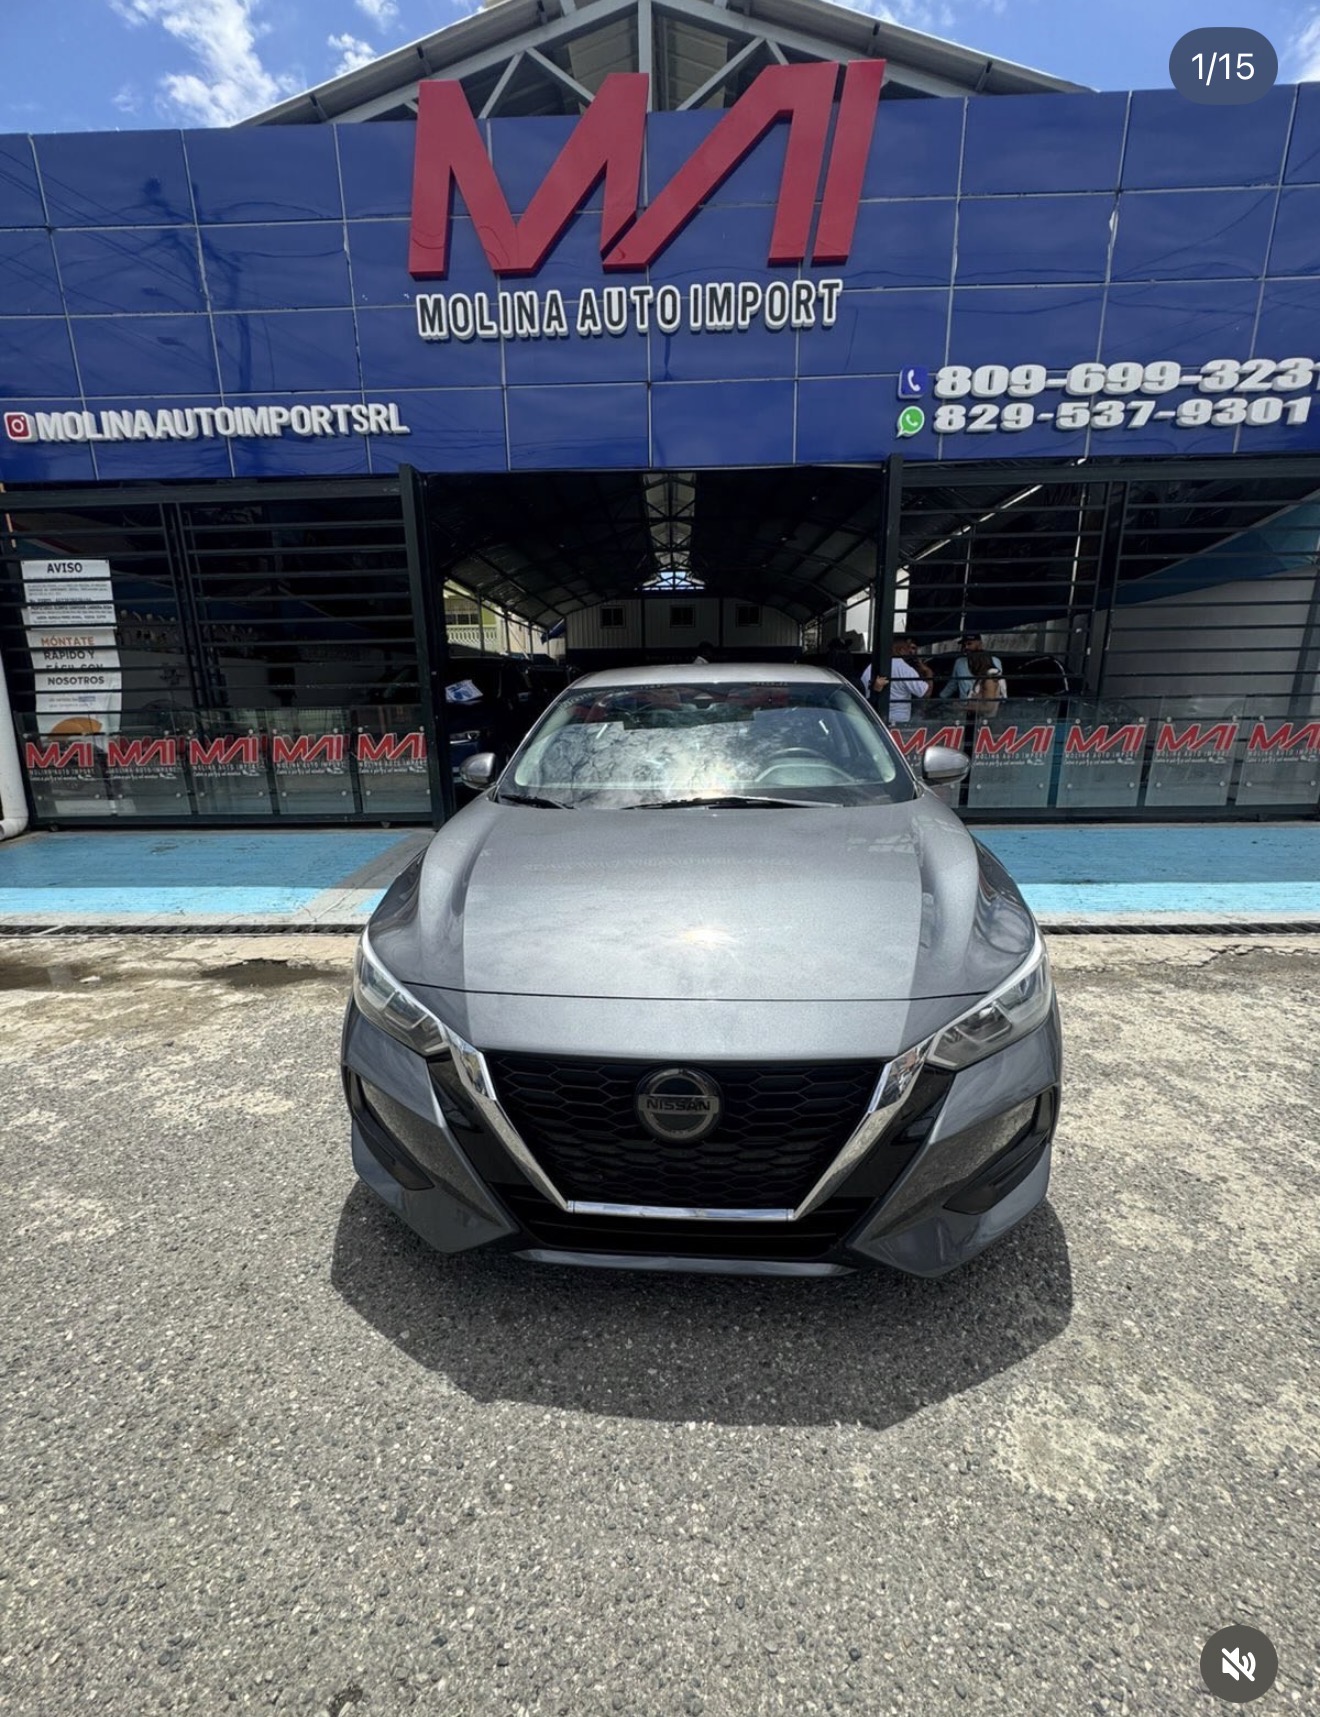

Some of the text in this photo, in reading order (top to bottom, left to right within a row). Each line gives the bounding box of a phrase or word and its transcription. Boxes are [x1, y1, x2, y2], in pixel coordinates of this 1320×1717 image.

[416, 279, 843, 340] MOLINA AUTO IMPORT
[934, 357, 1320, 398] 809-699-323
[35, 403, 411, 441] MOLINAAUTOIMPORTSRL
[934, 396, 1312, 434] 829-537-9301
[47, 562, 83, 573] AVISO
[41, 635, 95, 647] MÓNTATE
[88, 649, 95, 660] Y
[47, 676, 105, 685] NOSOTROS
[646, 1097, 711, 1111] NISSAN
